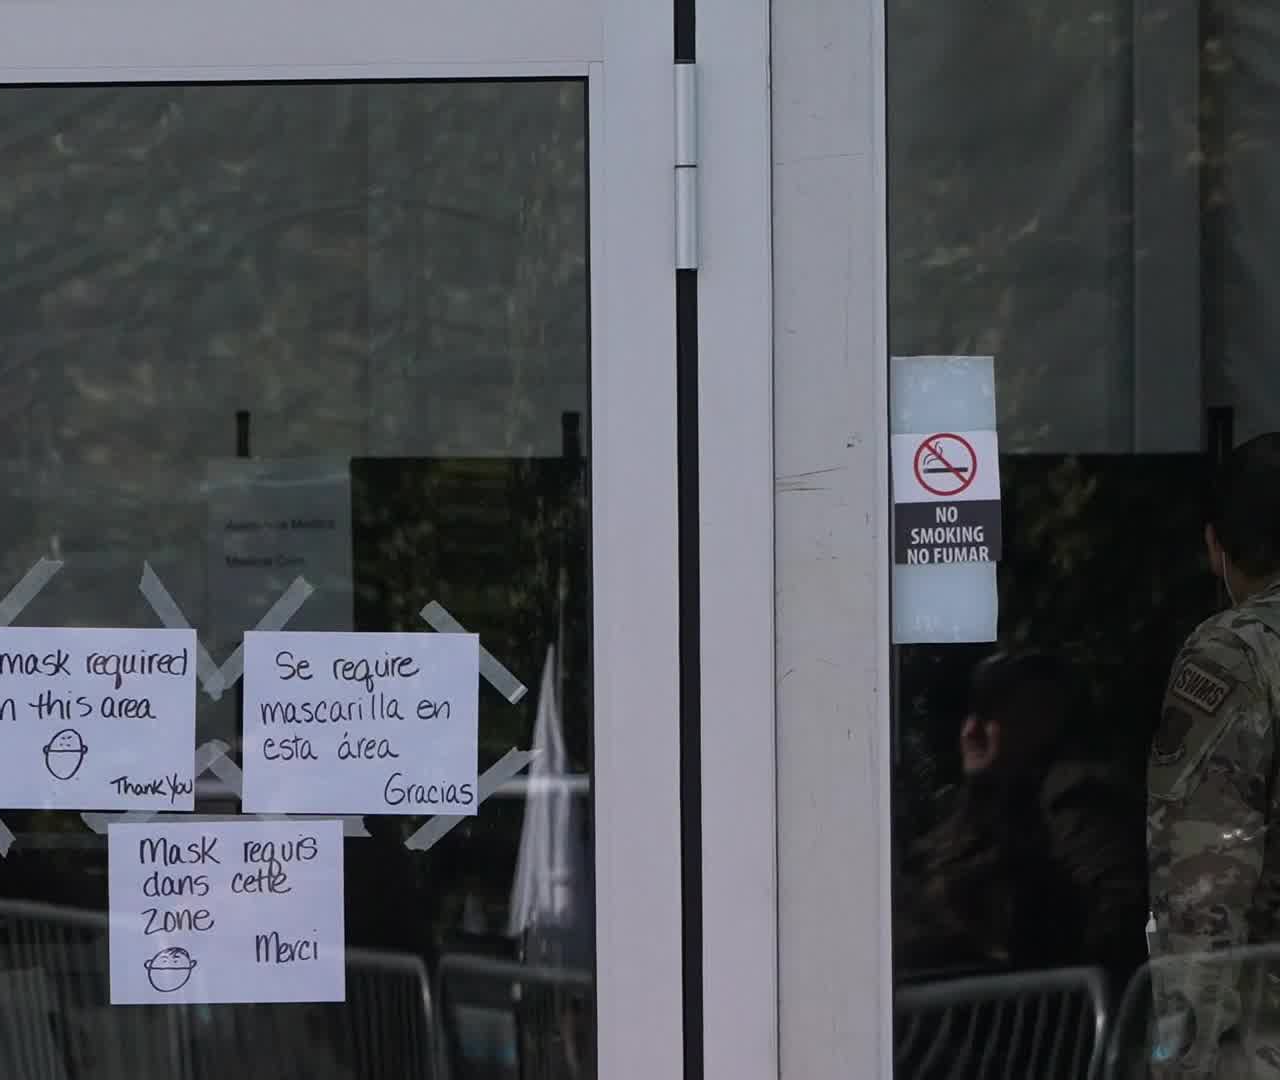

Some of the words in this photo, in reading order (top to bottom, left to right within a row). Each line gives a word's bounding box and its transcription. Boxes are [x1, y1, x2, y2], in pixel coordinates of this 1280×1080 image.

[935, 506, 958, 523] NO
[910, 525, 984, 545] SMOKING
[906, 549, 930, 565] NO
[933, 546, 989, 564] FUMAR
[86, 648, 187, 690] required
[275, 651, 313, 680] Se
[333, 653, 420, 693] require
[28, 689, 93, 720] this
[101, 696, 156, 719] area
[260, 692, 404, 725] mascarilla
[416, 699, 450, 720] en
[263, 735, 318, 760] esta
[337, 731, 400, 760] área
[165, 773, 193, 804] You
[384, 772, 474, 805] Gracias
[243, 834, 318, 877] requis
[143, 872, 210, 897] dans
[231, 867, 292, 894] cette
[255, 929, 318, 963] Merci
